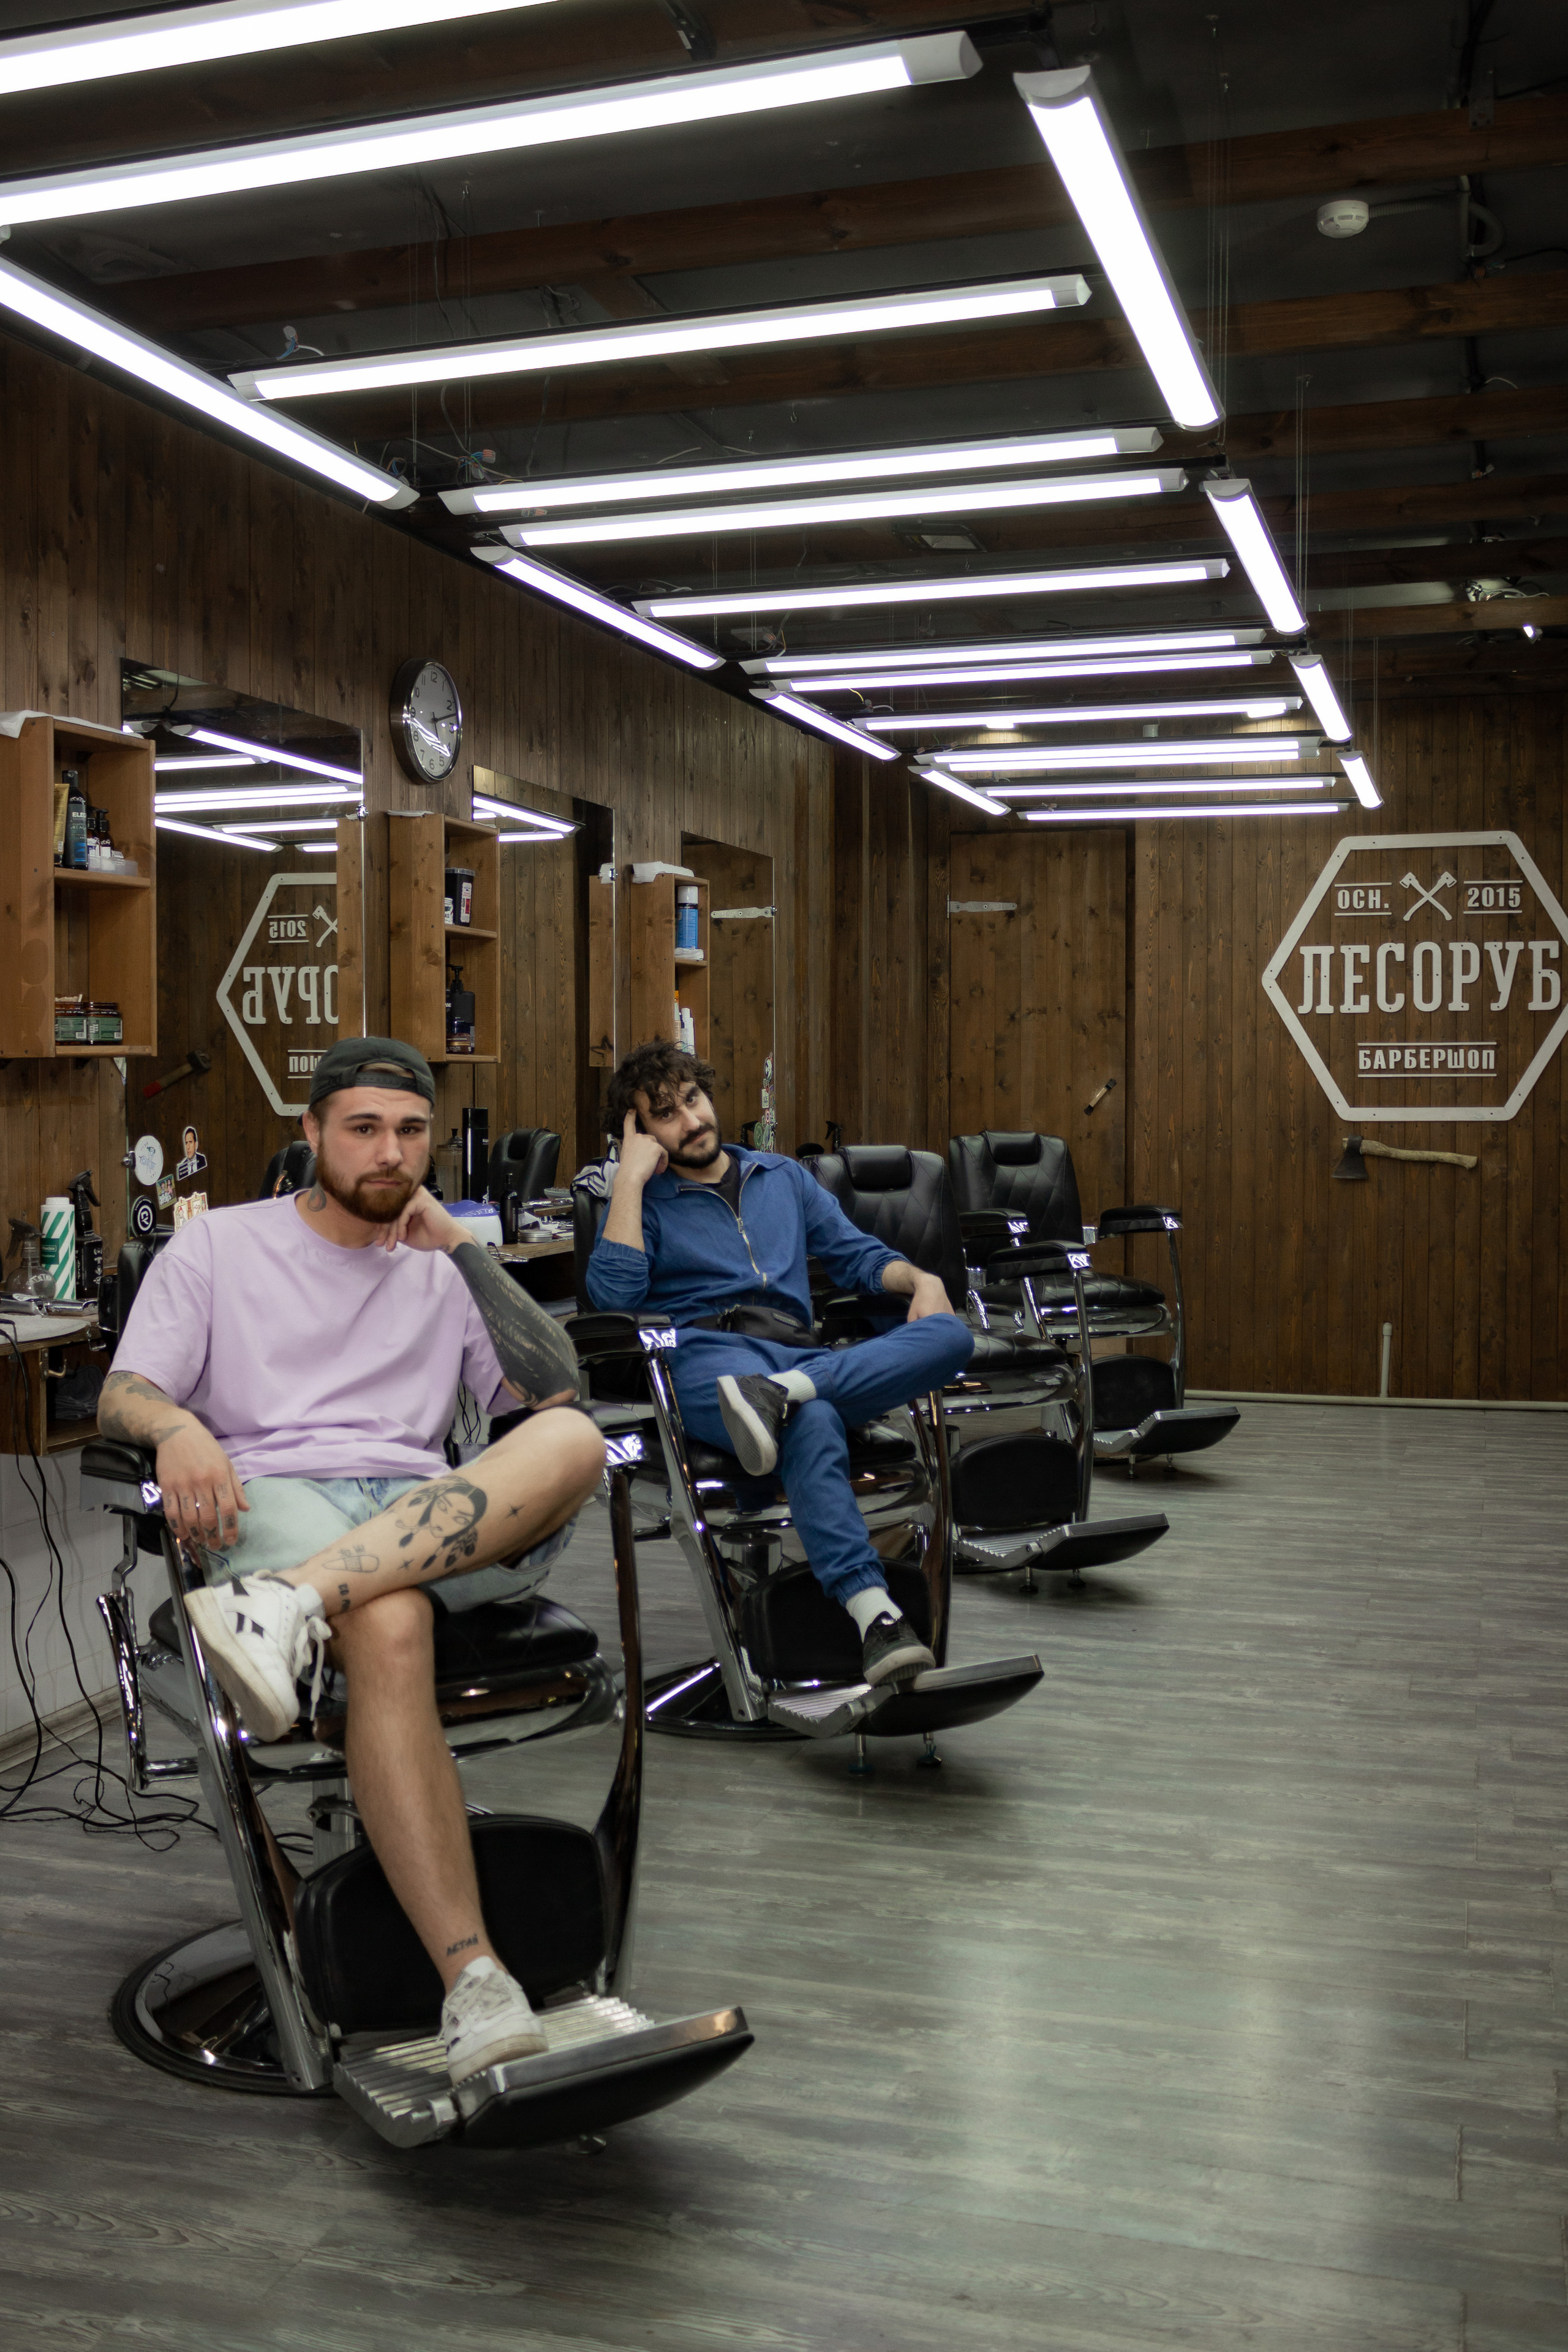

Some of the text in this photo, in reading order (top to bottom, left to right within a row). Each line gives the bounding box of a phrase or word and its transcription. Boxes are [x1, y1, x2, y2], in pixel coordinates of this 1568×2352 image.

[421, 675, 426, 685] 11
[431, 670, 437, 683] 12
[442, 681, 445, 692] 1
[415, 687, 420, 698] 10
[447, 699, 452, 710] 2
[410, 707, 416, 718] 9
[413, 730, 418, 741] 8
[420, 749, 424, 760] 7
[429, 759, 434, 770] 6
[439, 756, 444, 767] 5
[1337, 887, 1521, 910] ОСН. 2015
[1297, 941, 1561, 1014] ЛЕСОРУБ
[1358, 1049, 1496, 1070] БАРБЕРШОП
